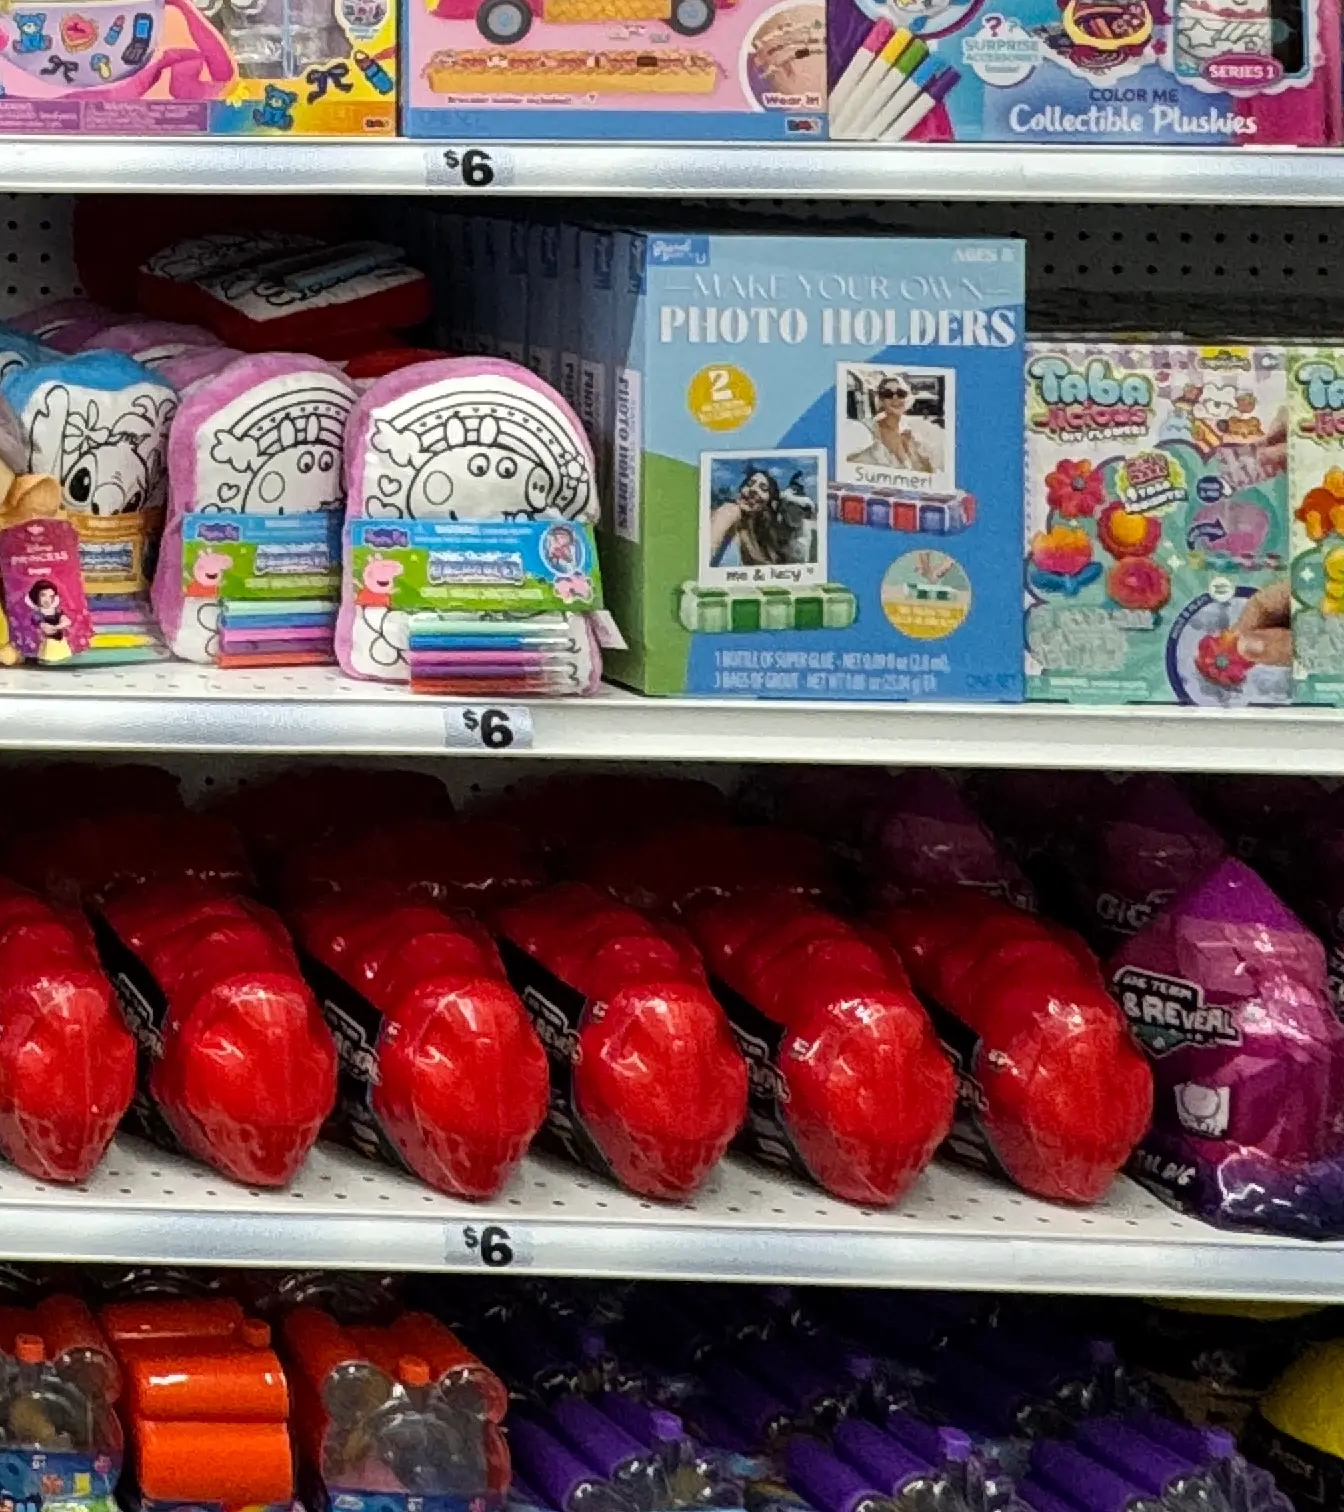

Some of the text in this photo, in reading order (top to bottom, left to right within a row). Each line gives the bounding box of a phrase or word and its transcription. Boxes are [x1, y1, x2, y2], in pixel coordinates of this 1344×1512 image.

[965, 39, 1039, 53] SURPRISE
[1209, 64, 1274, 80] SERIES 1
[1089, 88, 1179, 104] COLOR ME
[1010, 104, 1258, 136] Collectible Plushies
[443, 149, 494, 187] $6
[952, 248, 998, 262] AGES
[693, 274, 985, 302] MAKE YOUR OWN
[660, 304, 1016, 348] PHOTO HOLDERS
[708, 370, 733, 400] 2
[1027, 355, 1153, 406] Taba
[11, 551, 69, 566] PRINCESS
[463, 707, 514, 749] $6
[1142, 996, 1236, 1037] REVEAL
[463, 1225, 513, 1268] $6
